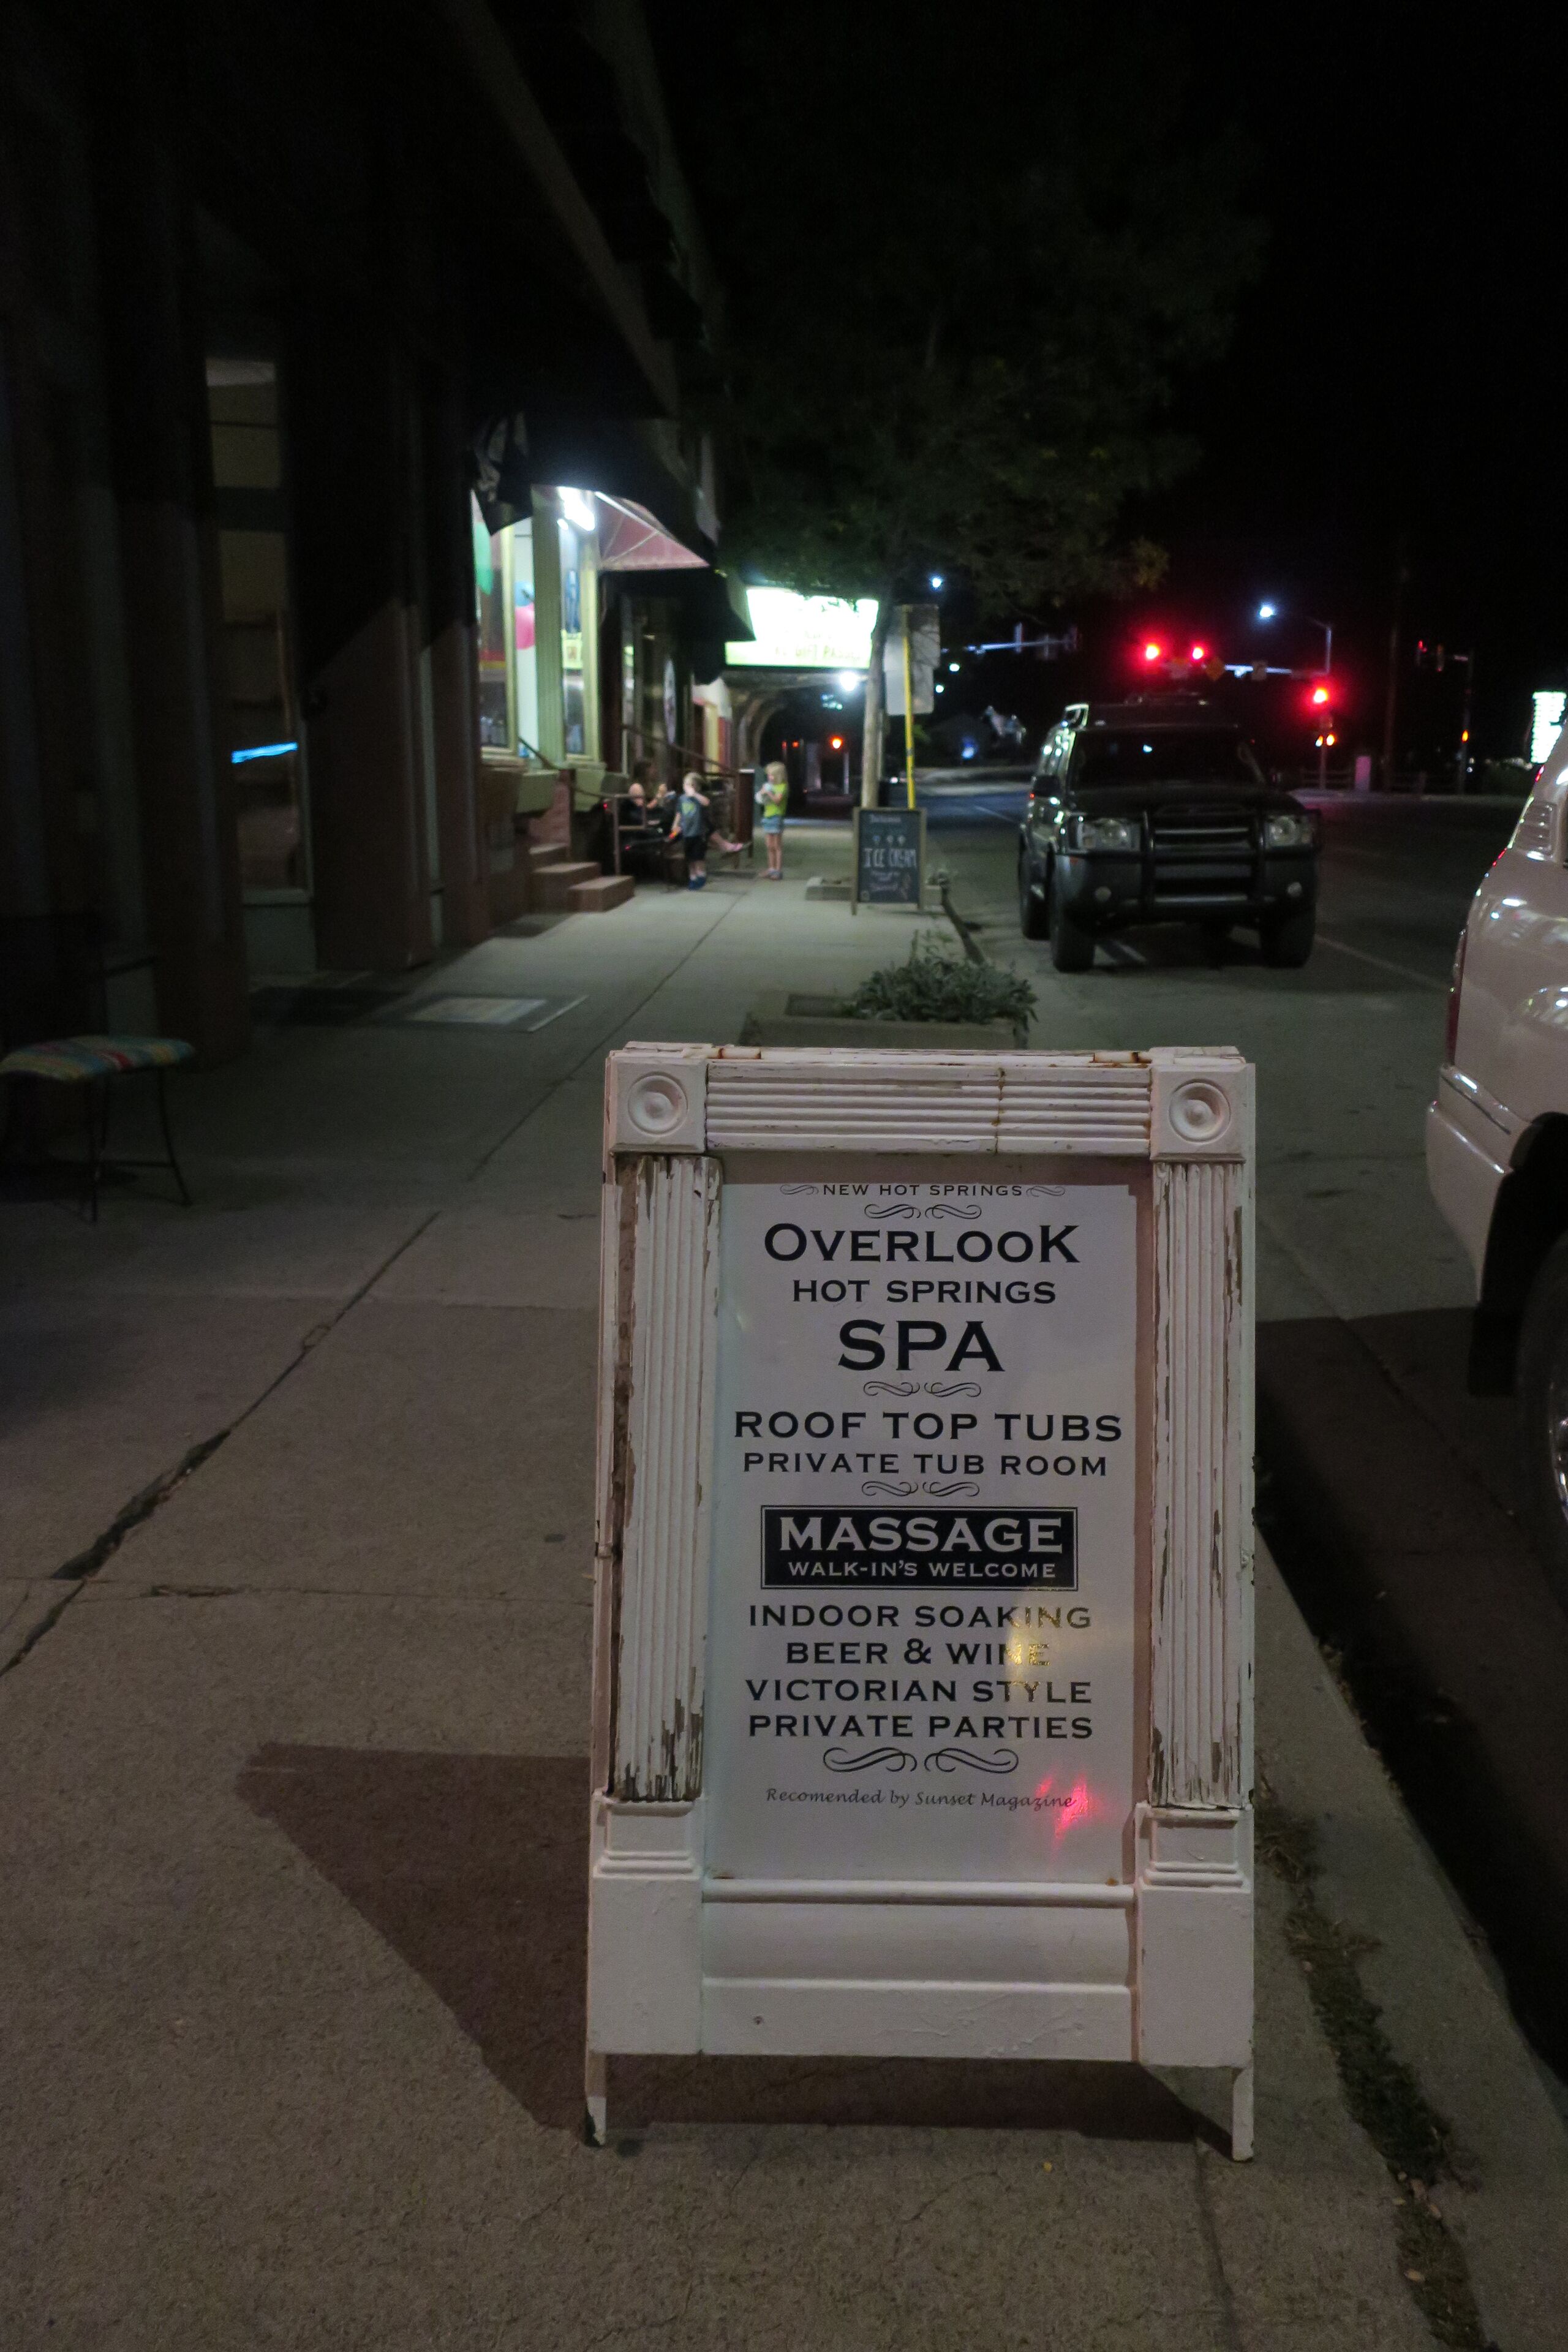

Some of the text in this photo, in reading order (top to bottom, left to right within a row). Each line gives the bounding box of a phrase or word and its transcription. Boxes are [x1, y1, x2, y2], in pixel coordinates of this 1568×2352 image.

[823, 1184, 1022, 1196] NEW HOT SPRINGS
[764, 1223, 1080, 1263] OVERLOOK
[793, 1280, 1056, 1305] HOT SPRINGS
[838, 1319, 1005, 1372] SPA
[734, 1411, 1121, 1442] ROOF TOP TUBS
[744, 1452, 1106, 1476] PRIVATE TUB ROOM
[780, 1517, 1063, 1553] MASSAGE
[928, 1562, 1056, 1578] WELCOME
[750, 1604, 1091, 1629] INDOOR SOAKING
[786, 1638, 1049, 1666] BEER & WINE
[745, 1679, 1091, 1704] VICTORIAN STYLE
[749, 1714, 1093, 1740] PRIVATE PARTIES
[766, 1787, 1076, 1812] Recomended by Sunset Magazine
